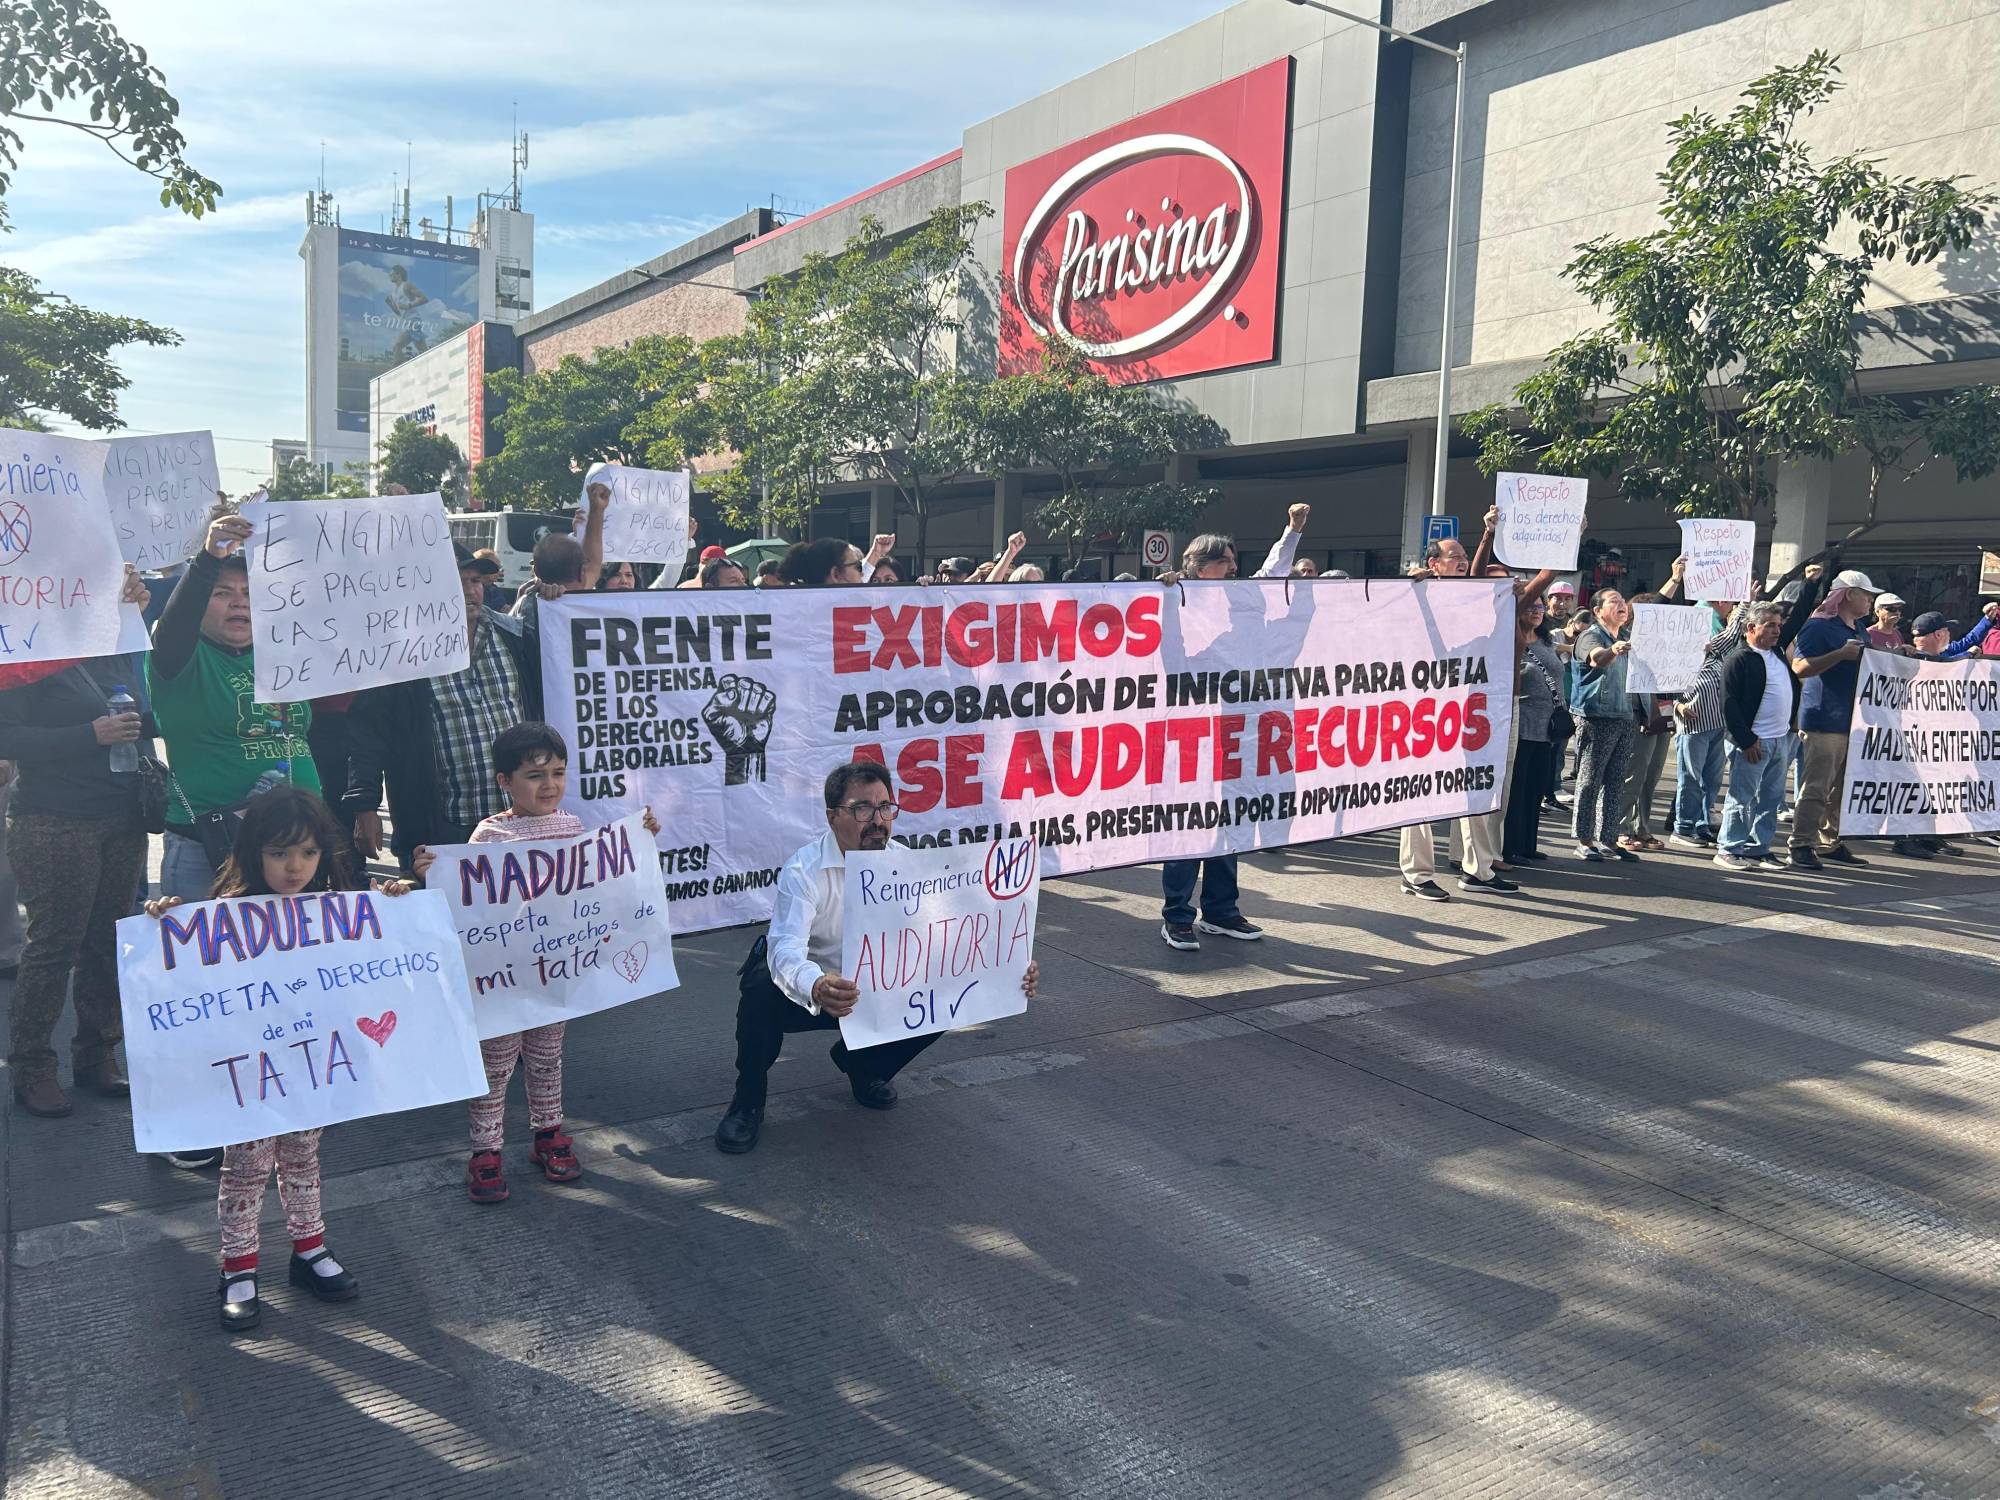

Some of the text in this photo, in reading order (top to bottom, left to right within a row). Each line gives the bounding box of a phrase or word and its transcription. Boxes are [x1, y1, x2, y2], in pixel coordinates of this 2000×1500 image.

[1055, 196, 1231, 302] Parisina
[127, 478, 215, 510] PAGUEN
[151, 511, 208, 538] PRIMA
[630, 513, 685, 532] PAGUE
[1500, 506, 1580, 525] a los derechos
[627, 537, 685, 558] BECAS
[1150, 540, 1164, 554] 30
[1512, 528, 1568, 548] adquiridos!
[1692, 521, 1740, 546] Respeto
[0, 575, 90, 609] TORIA
[260, 565, 432, 612] SE PAGUEN
[1724, 572, 1749, 600] NO!
[271, 594, 460, 647] LAS PRIMAS
[832, 595, 1162, 674] EXIGIMOS
[1638, 608, 1712, 637] EXIGIMOS
[571, 613, 773, 667] FRENTE
[271, 657, 313, 692] DE
[574, 667, 718, 696] DE DEFENSA
[576, 695, 658, 723] DE LOS
[833, 669, 1106, 733] APROBACIÓN
[1113, 673, 1157, 711] DE
[1166, 665, 1330, 707] INICIATIVA
[1335, 662, 1406, 698] PARA
[1411, 658, 1462, 693] QUE
[1464, 656, 1488, 685] LA
[1915, 679, 1967, 711] FORENSE
[1970, 680, 1998, 712] POR
[577, 718, 699, 749] DERECHOS
[1000, 714, 1246, 801] AUDITE
[1257, 692, 1491, 777] RECURSOS
[1932, 730, 2000, 763] ENTIENDE
[579, 742, 713, 775] LABORALES
[580, 774, 627, 801] UAS
[1086, 796, 1231, 841] PRESENTADA
[1235, 792, 1274, 826] POR
[1278, 790, 1298, 821] EL
[1301, 780, 1381, 817] DIPUTADO
[1384, 772, 1432, 804] SERGIO
[1435, 765, 1494, 797] TORRES
[1848, 780, 1996, 815] FRENTE DE DEFENSA
[459, 824, 636, 907] MADUEÑA
[860, 864, 983, 917] Reingenieria
[532, 900, 656, 954] derechos de
[573, 900, 601, 920] los
[160, 891, 382, 971] MADUEÑA
[854, 902, 1031, 993] AUDITORIA
[475, 939, 601, 996] mi tatá
[147, 951, 440, 1031] RESPETA los DERECHOS
[904, 989, 935, 1030] SI
[262, 1012, 314, 1042] de mi
[211, 1030, 358, 1108] TATA
